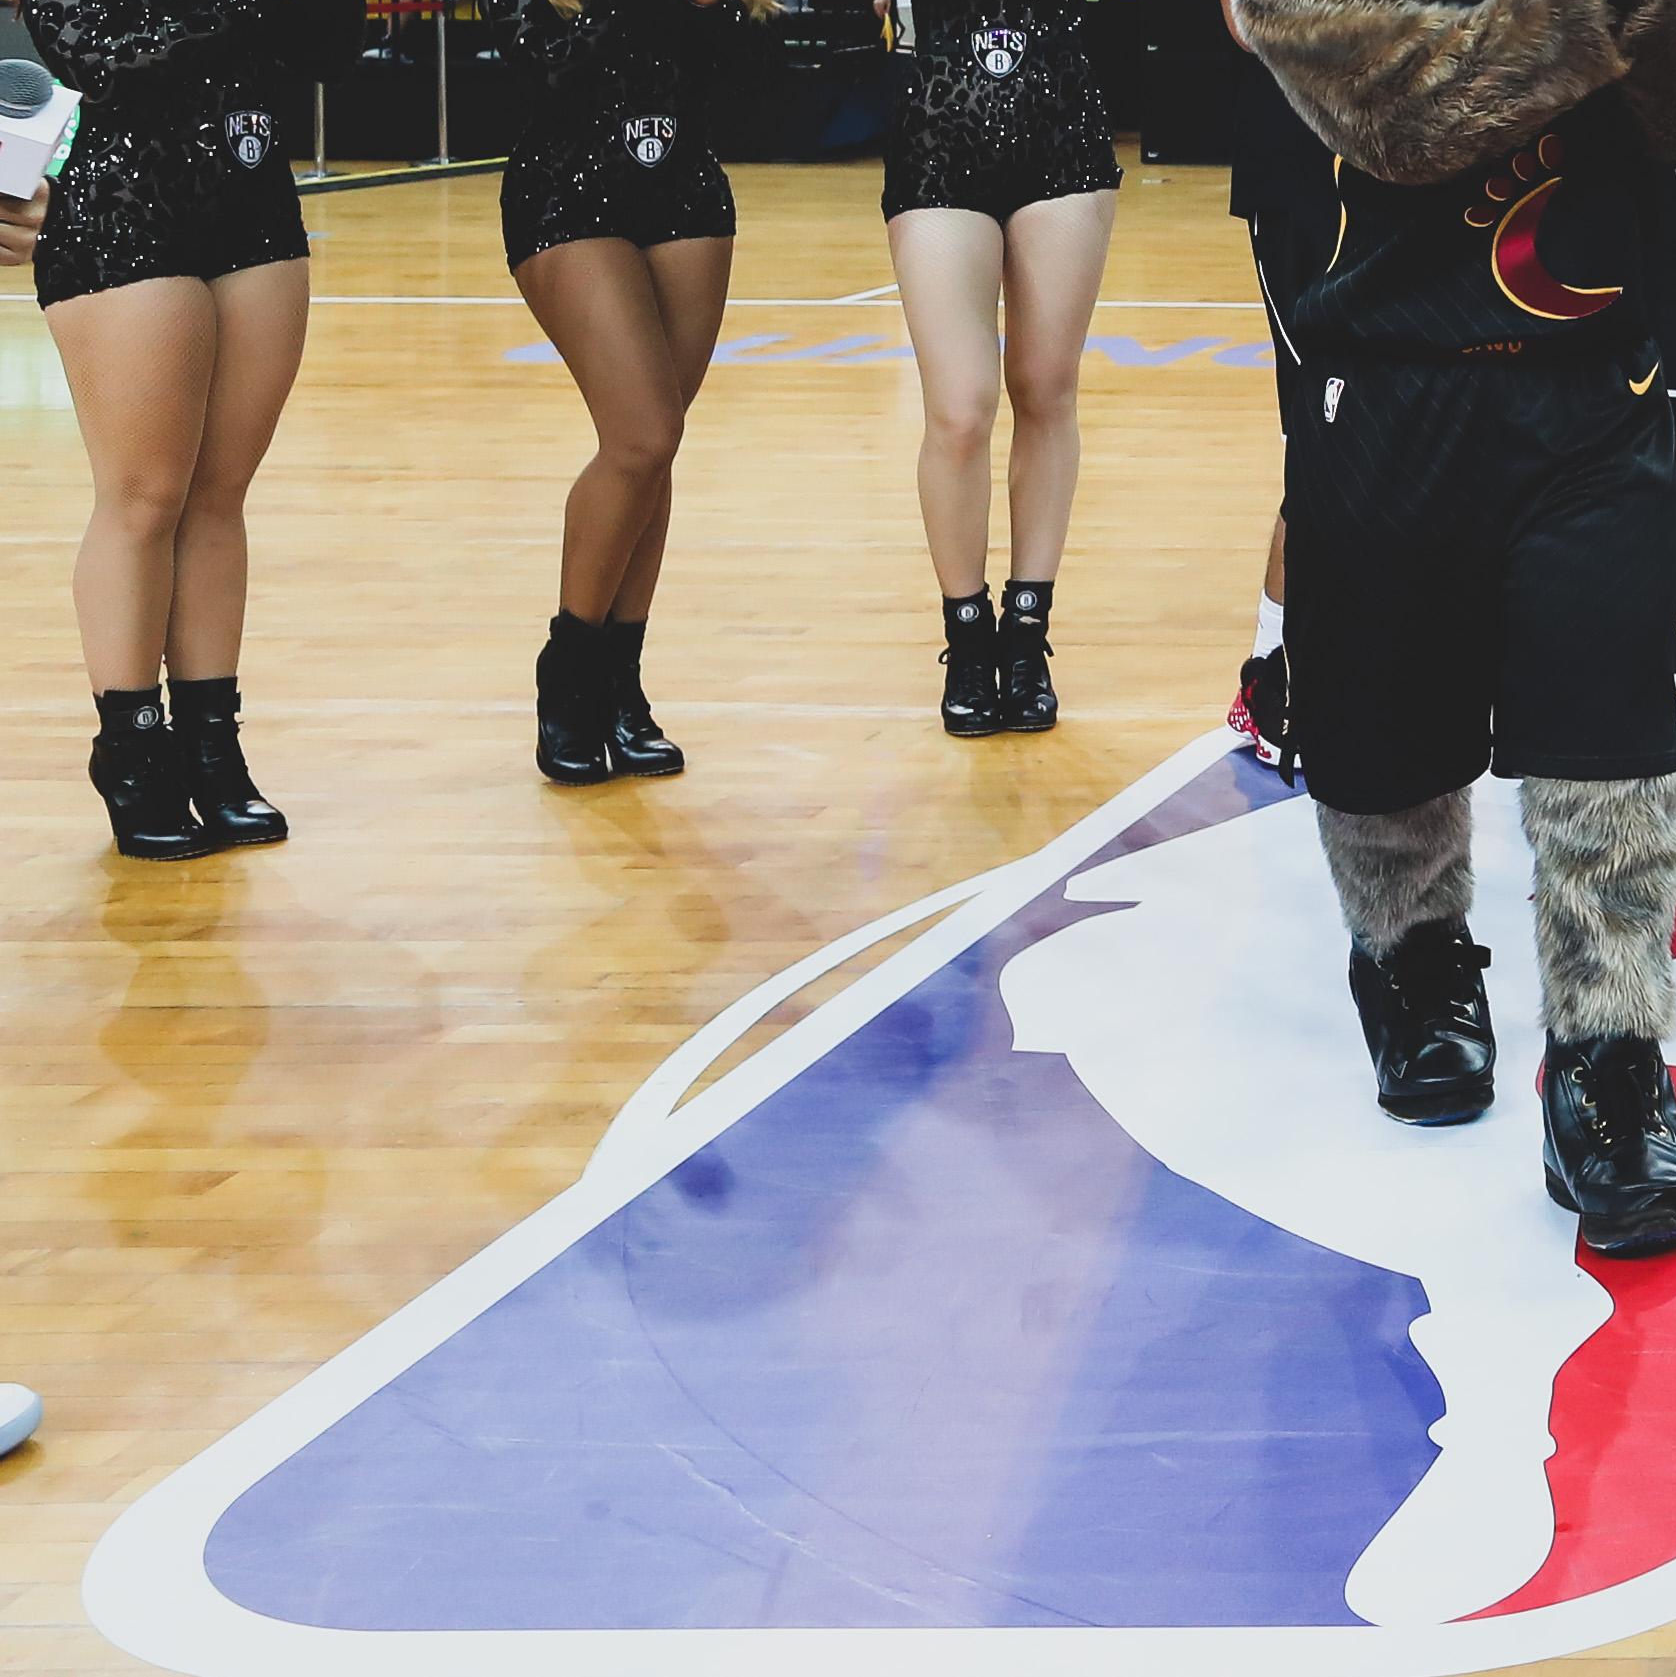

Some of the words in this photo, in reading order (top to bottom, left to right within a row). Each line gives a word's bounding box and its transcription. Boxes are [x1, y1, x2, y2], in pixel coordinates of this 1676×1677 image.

[974, 29, 1024, 52] NETS
[228, 113, 271, 138] NETS
[625, 117, 674, 142] NETS
